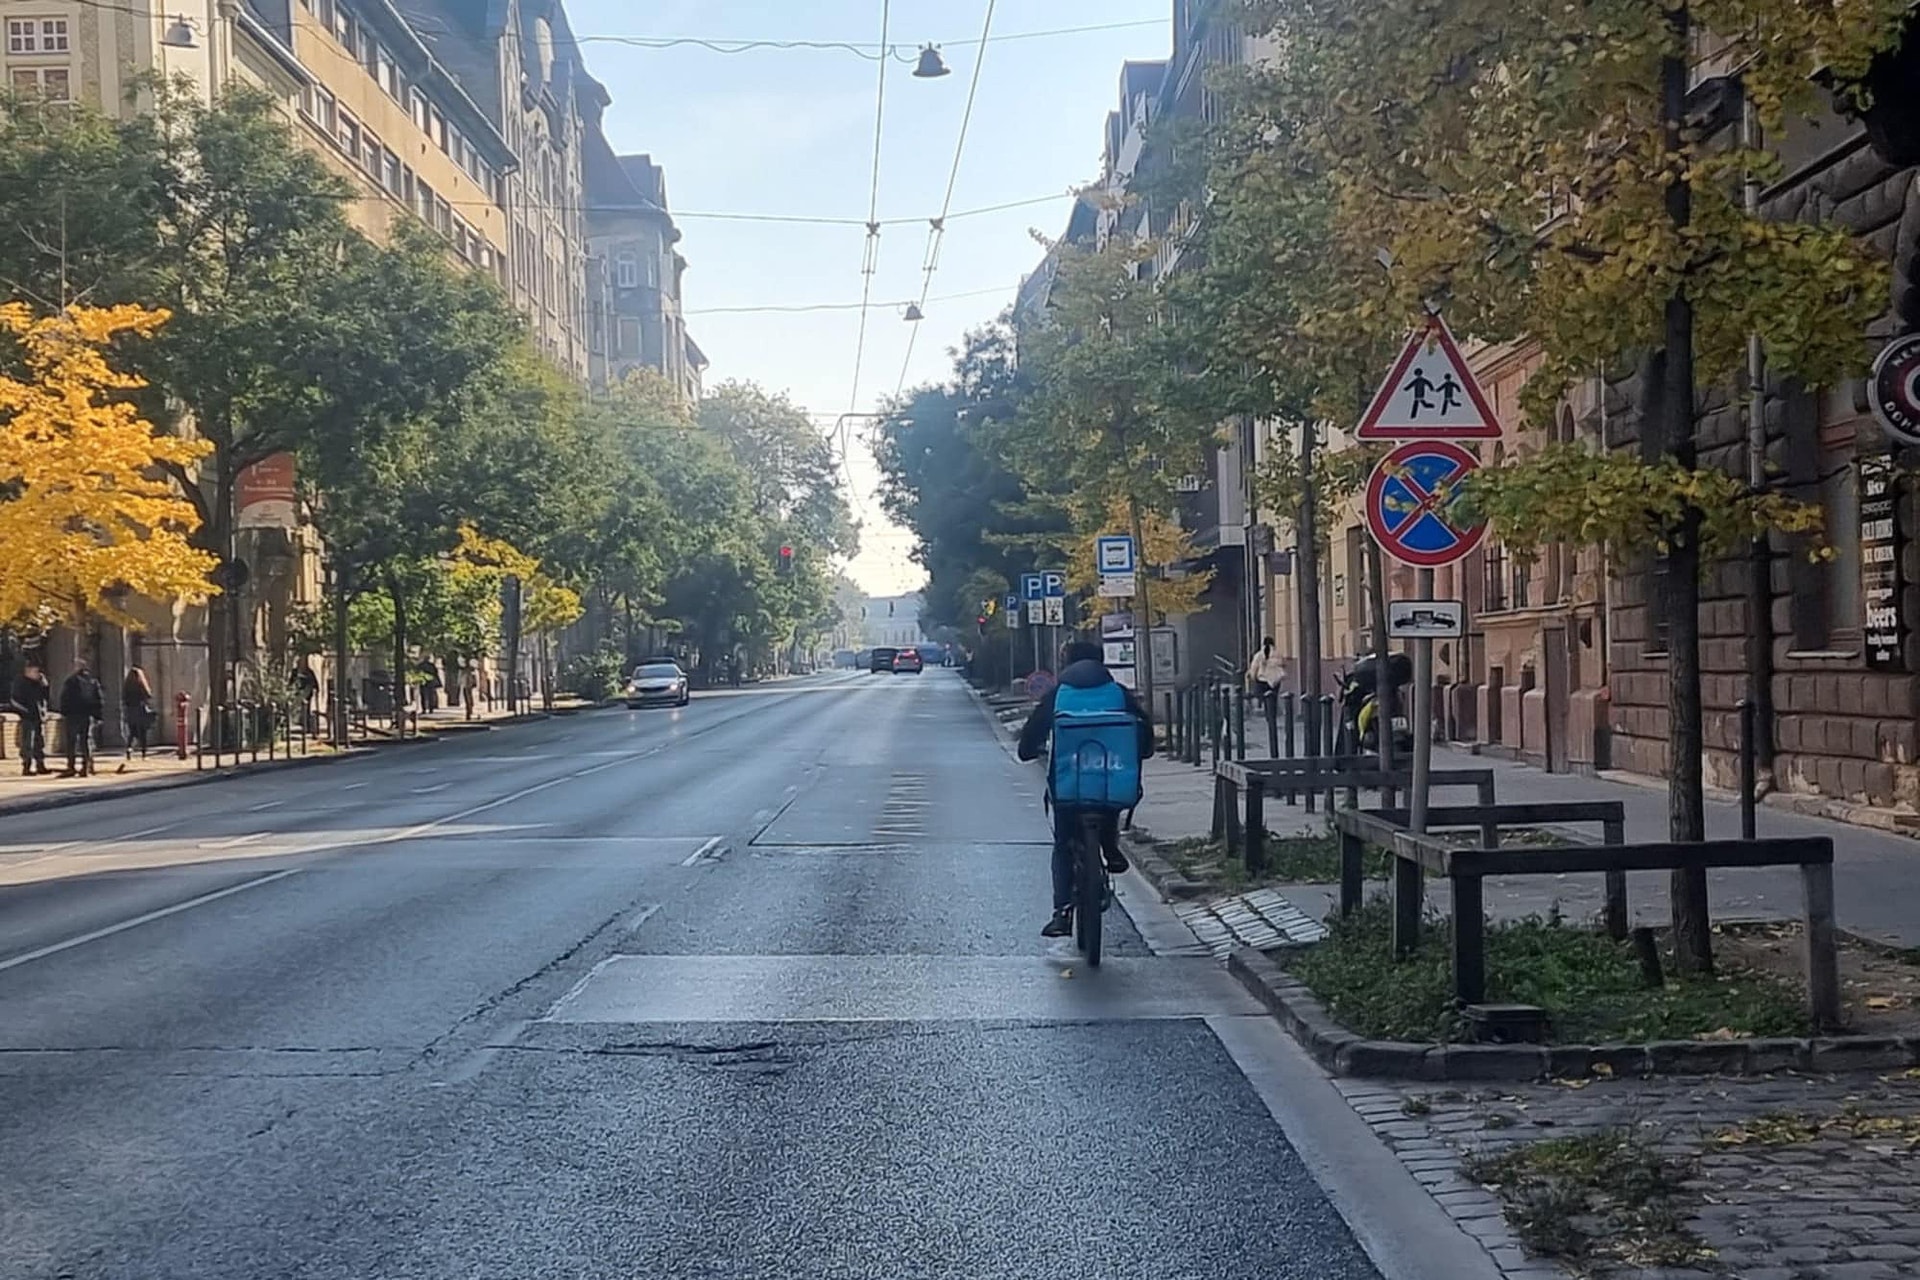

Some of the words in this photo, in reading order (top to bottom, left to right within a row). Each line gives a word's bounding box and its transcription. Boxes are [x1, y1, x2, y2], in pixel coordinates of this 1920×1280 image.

[1028, 578, 1041, 598] P
[1046, 574, 1061, 595] P
[1006, 596, 1017, 609] P
[1866, 601, 1897, 628] beers
